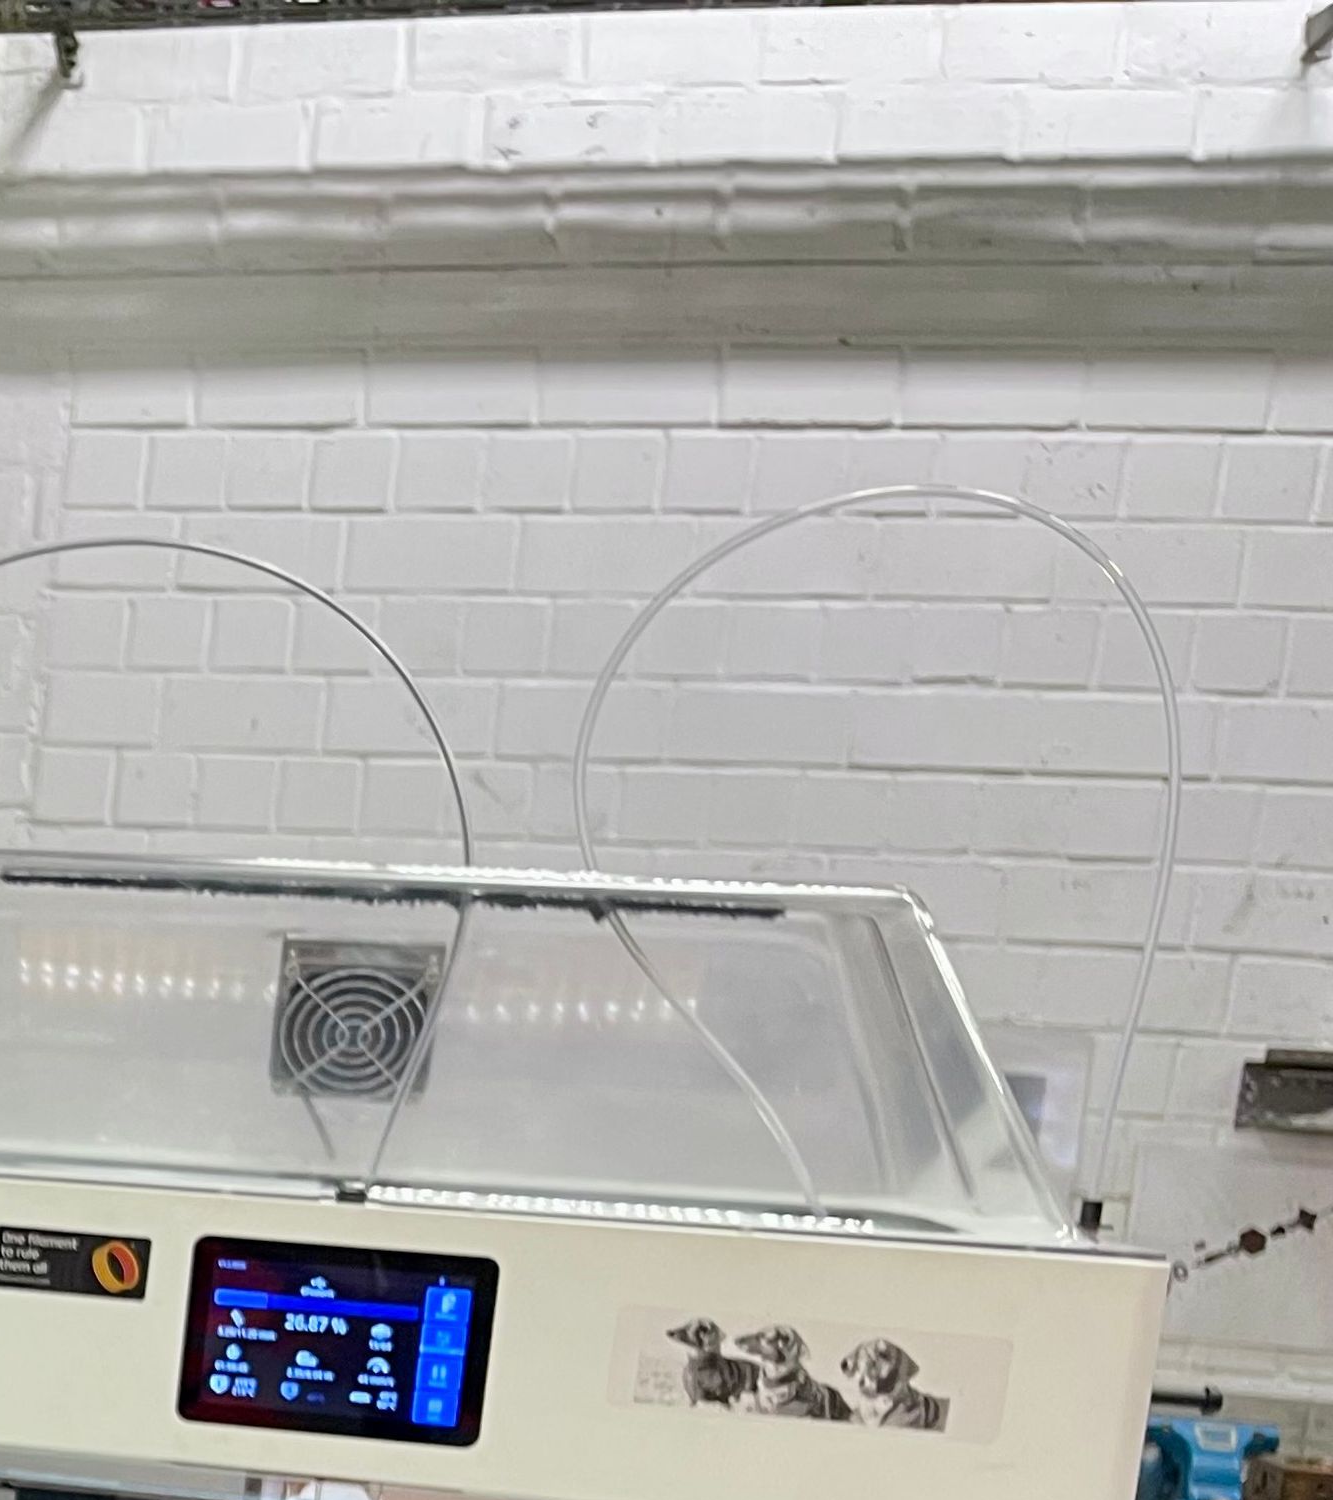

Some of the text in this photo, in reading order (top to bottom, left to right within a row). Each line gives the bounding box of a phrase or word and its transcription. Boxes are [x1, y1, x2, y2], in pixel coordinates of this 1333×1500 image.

[2, 1231, 77, 1250] One filament
[0, 1258, 30, 1272] them
